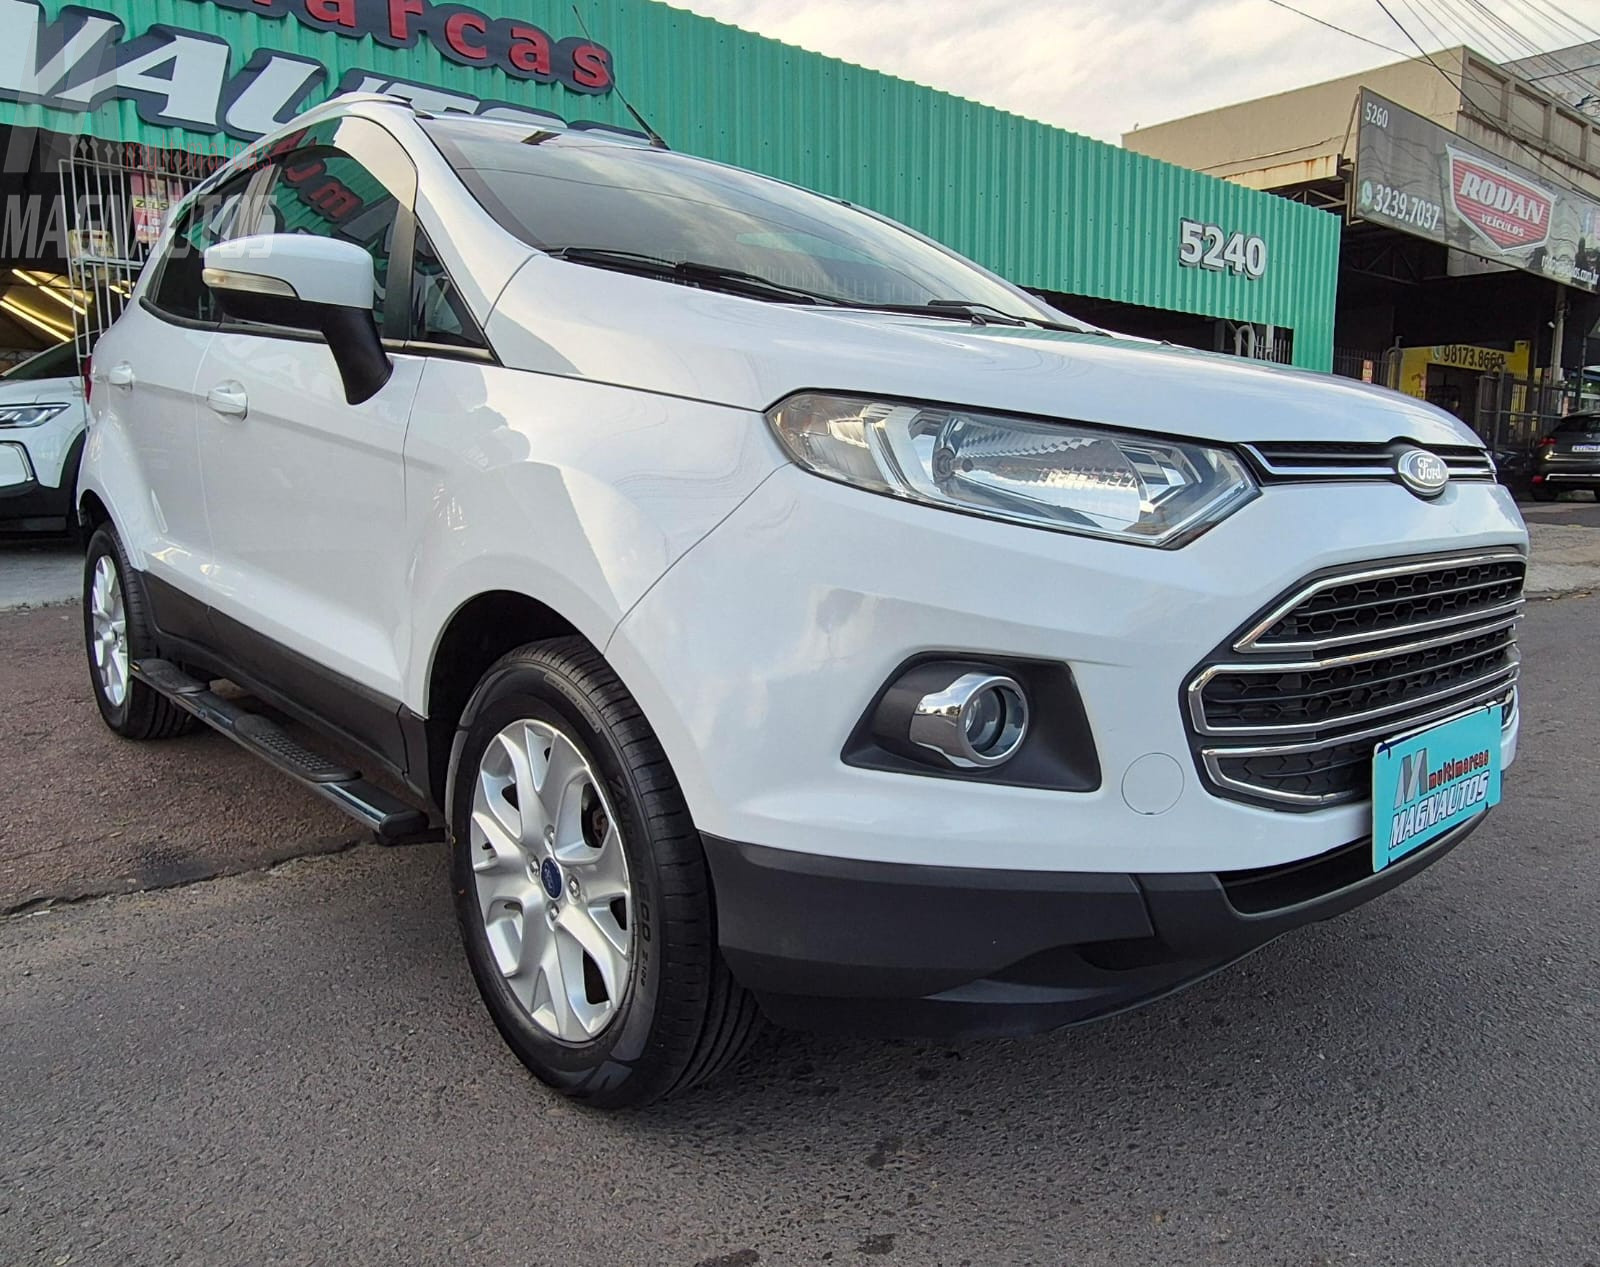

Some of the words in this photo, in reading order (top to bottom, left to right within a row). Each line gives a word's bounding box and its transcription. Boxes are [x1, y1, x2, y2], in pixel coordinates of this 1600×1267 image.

[254, 0, 612, 88] arcas
[1365, 102, 1389, 129] 5260
[1374, 184, 1441, 231] 3239.7037
[1459, 172, 1544, 224] RODAN
[1181, 220, 1267, 279] 5240
[1481, 214, 1525, 237] VEÍCULOS
[1417, 456, 1442, 480] Ford
[1389, 770, 1489, 851] MAGNAUTOS
